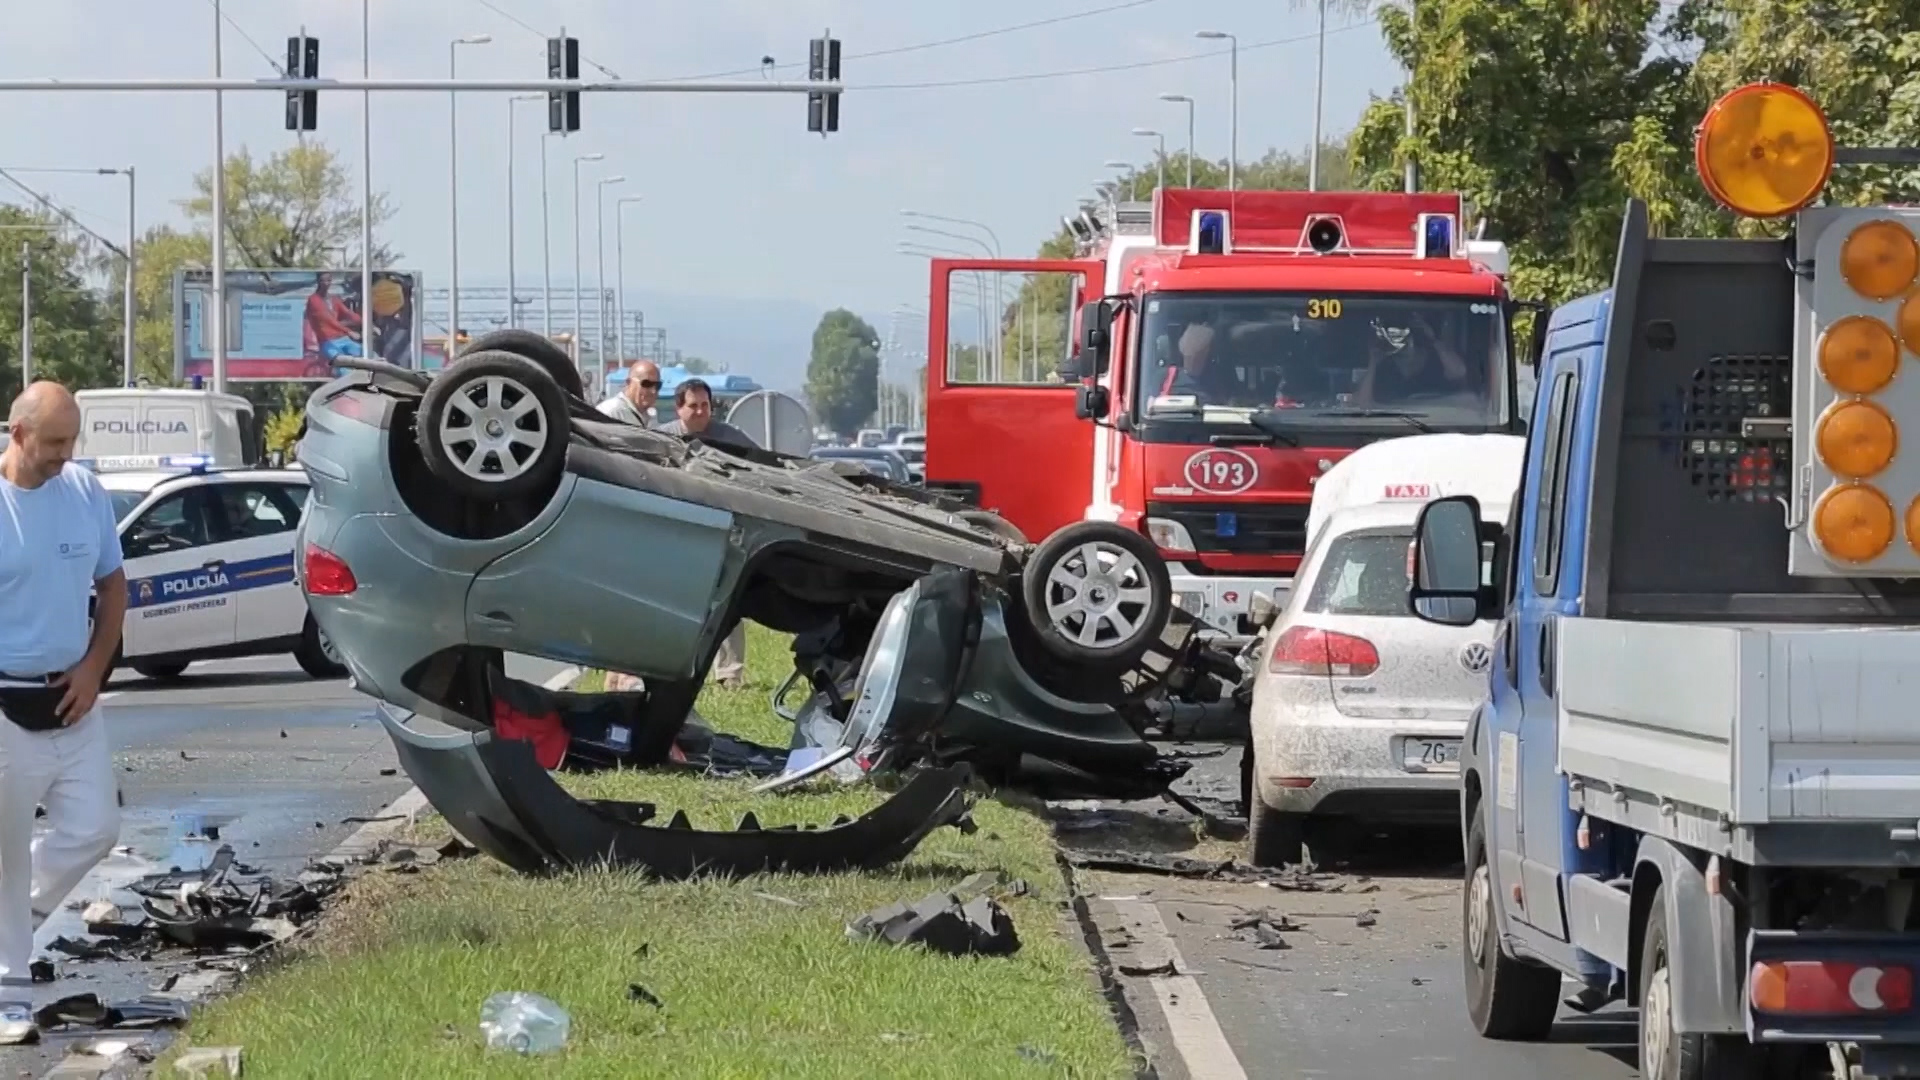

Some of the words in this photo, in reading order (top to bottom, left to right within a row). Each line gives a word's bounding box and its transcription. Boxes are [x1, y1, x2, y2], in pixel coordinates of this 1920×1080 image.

[1307, 298, 1342, 319] 310
[93, 421, 188, 434] POLICIJA
[101, 457, 156, 468] POLICIJA
[1202, 461, 1244, 486] 193
[1384, 485, 1430, 498] TAXI
[162, 573, 230, 595] POLICIJA
[1421, 743, 1445, 764] ZG
